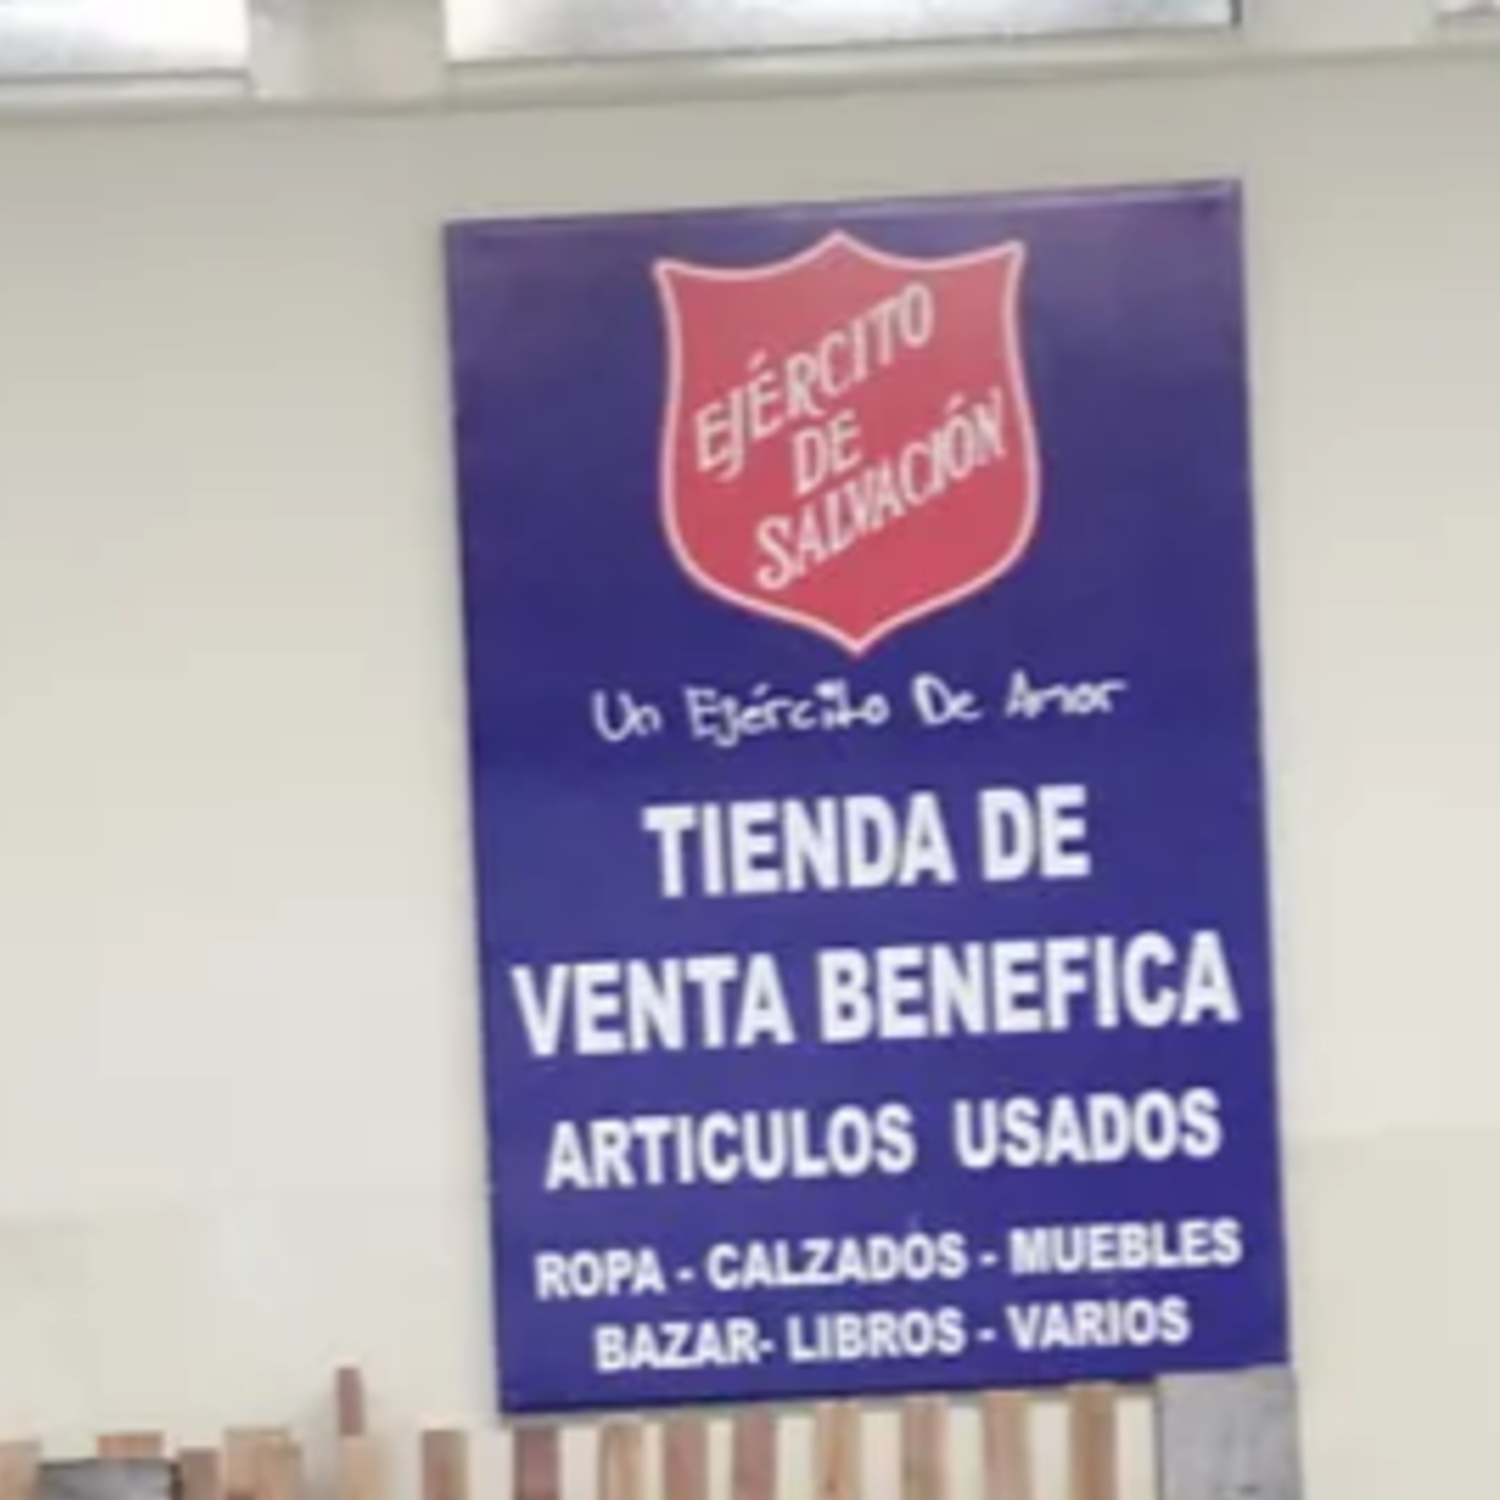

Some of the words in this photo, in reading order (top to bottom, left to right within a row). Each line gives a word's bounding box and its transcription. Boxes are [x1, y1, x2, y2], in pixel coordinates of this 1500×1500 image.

[695, 282, 934, 482] EJÉRCITO
[756, 386, 1006, 590] SALVACIÓN
[793, 410, 861, 494] DE
[592, 690, 662, 743] Un
[911, 673, 982, 726] De
[1004, 669, 1128, 719] Amor
[641, 791, 958, 899] TIENDA
[978, 783, 1092, 882] DE
[509, 952, 796, 1058] VENTA
[816, 929, 1240, 1044] BENEFICA
[544, 1102, 917, 1192] ARTICULOS
[953, 1086, 1223, 1170] USADOS
[534, 1248, 667, 1302] ROPA
[705, 1230, 970, 1293] CALZADOS
[1008, 1216, 1244, 1276] MUEBLES
[786, 1305, 967, 1364] LIBROS
[1005, 1295, 1192, 1352] VARIOS
